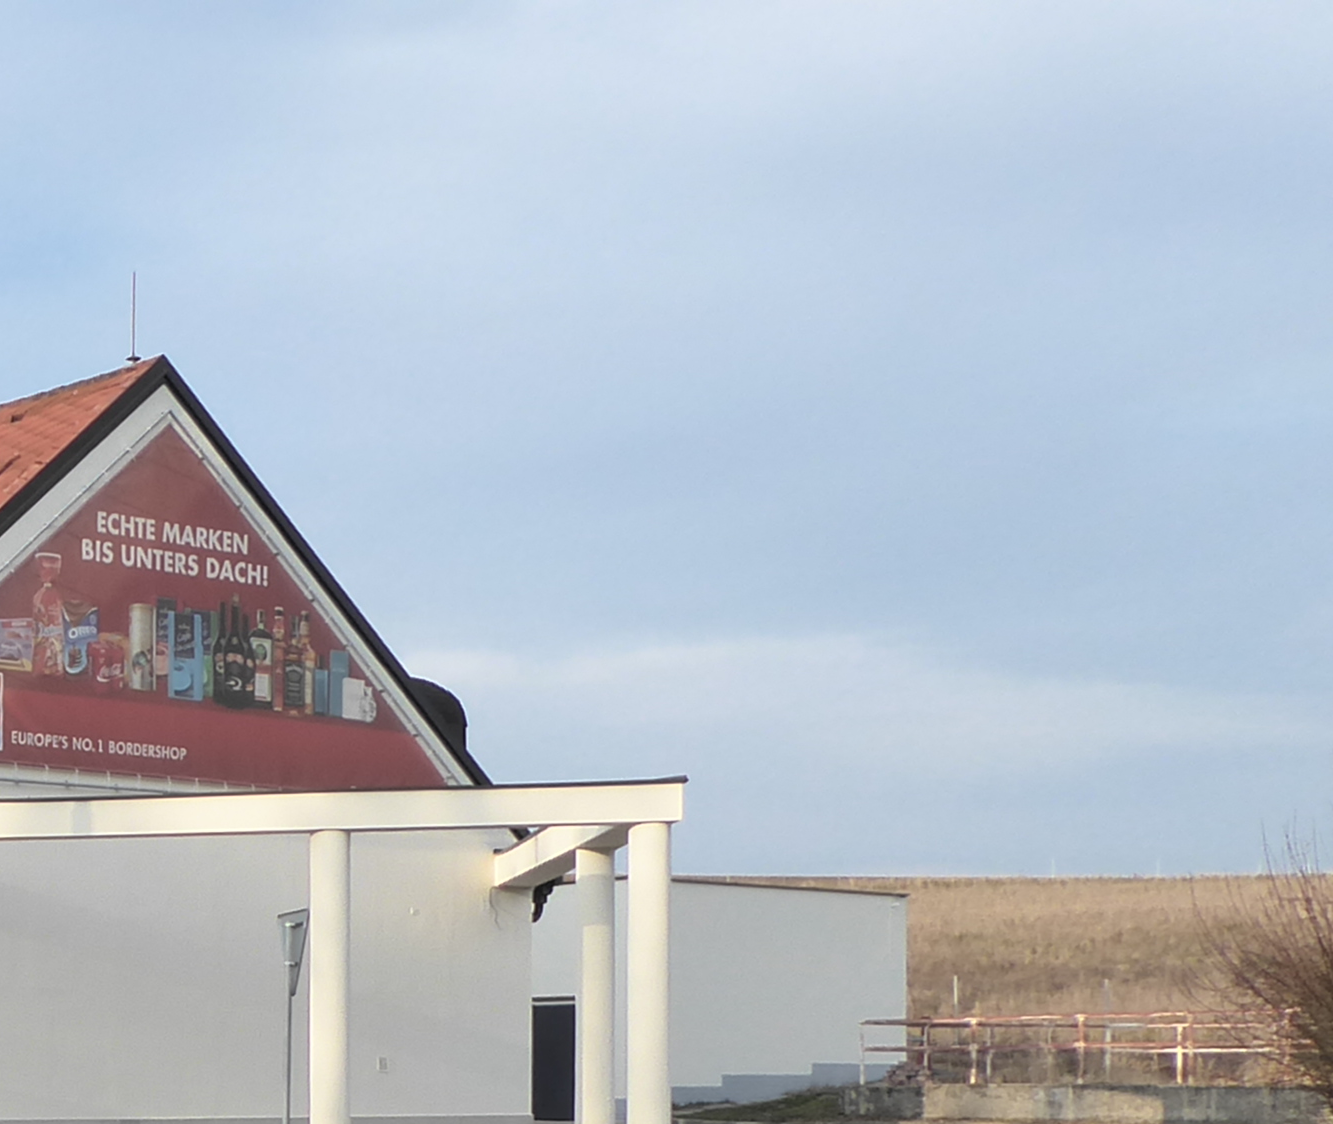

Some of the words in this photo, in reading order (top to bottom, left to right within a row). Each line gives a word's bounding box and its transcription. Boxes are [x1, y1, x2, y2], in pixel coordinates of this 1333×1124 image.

[96, 511, 156, 541] ECHTE
[162, 521, 249, 555] MARKEN
[81, 538, 114, 564] BIS
[121, 544, 199, 577] UNTERS
[206, 557, 269, 587] DACH!
[11, 730, 69, 749] EUROPE'S
[108, 740, 188, 761] BORDERSHOP
